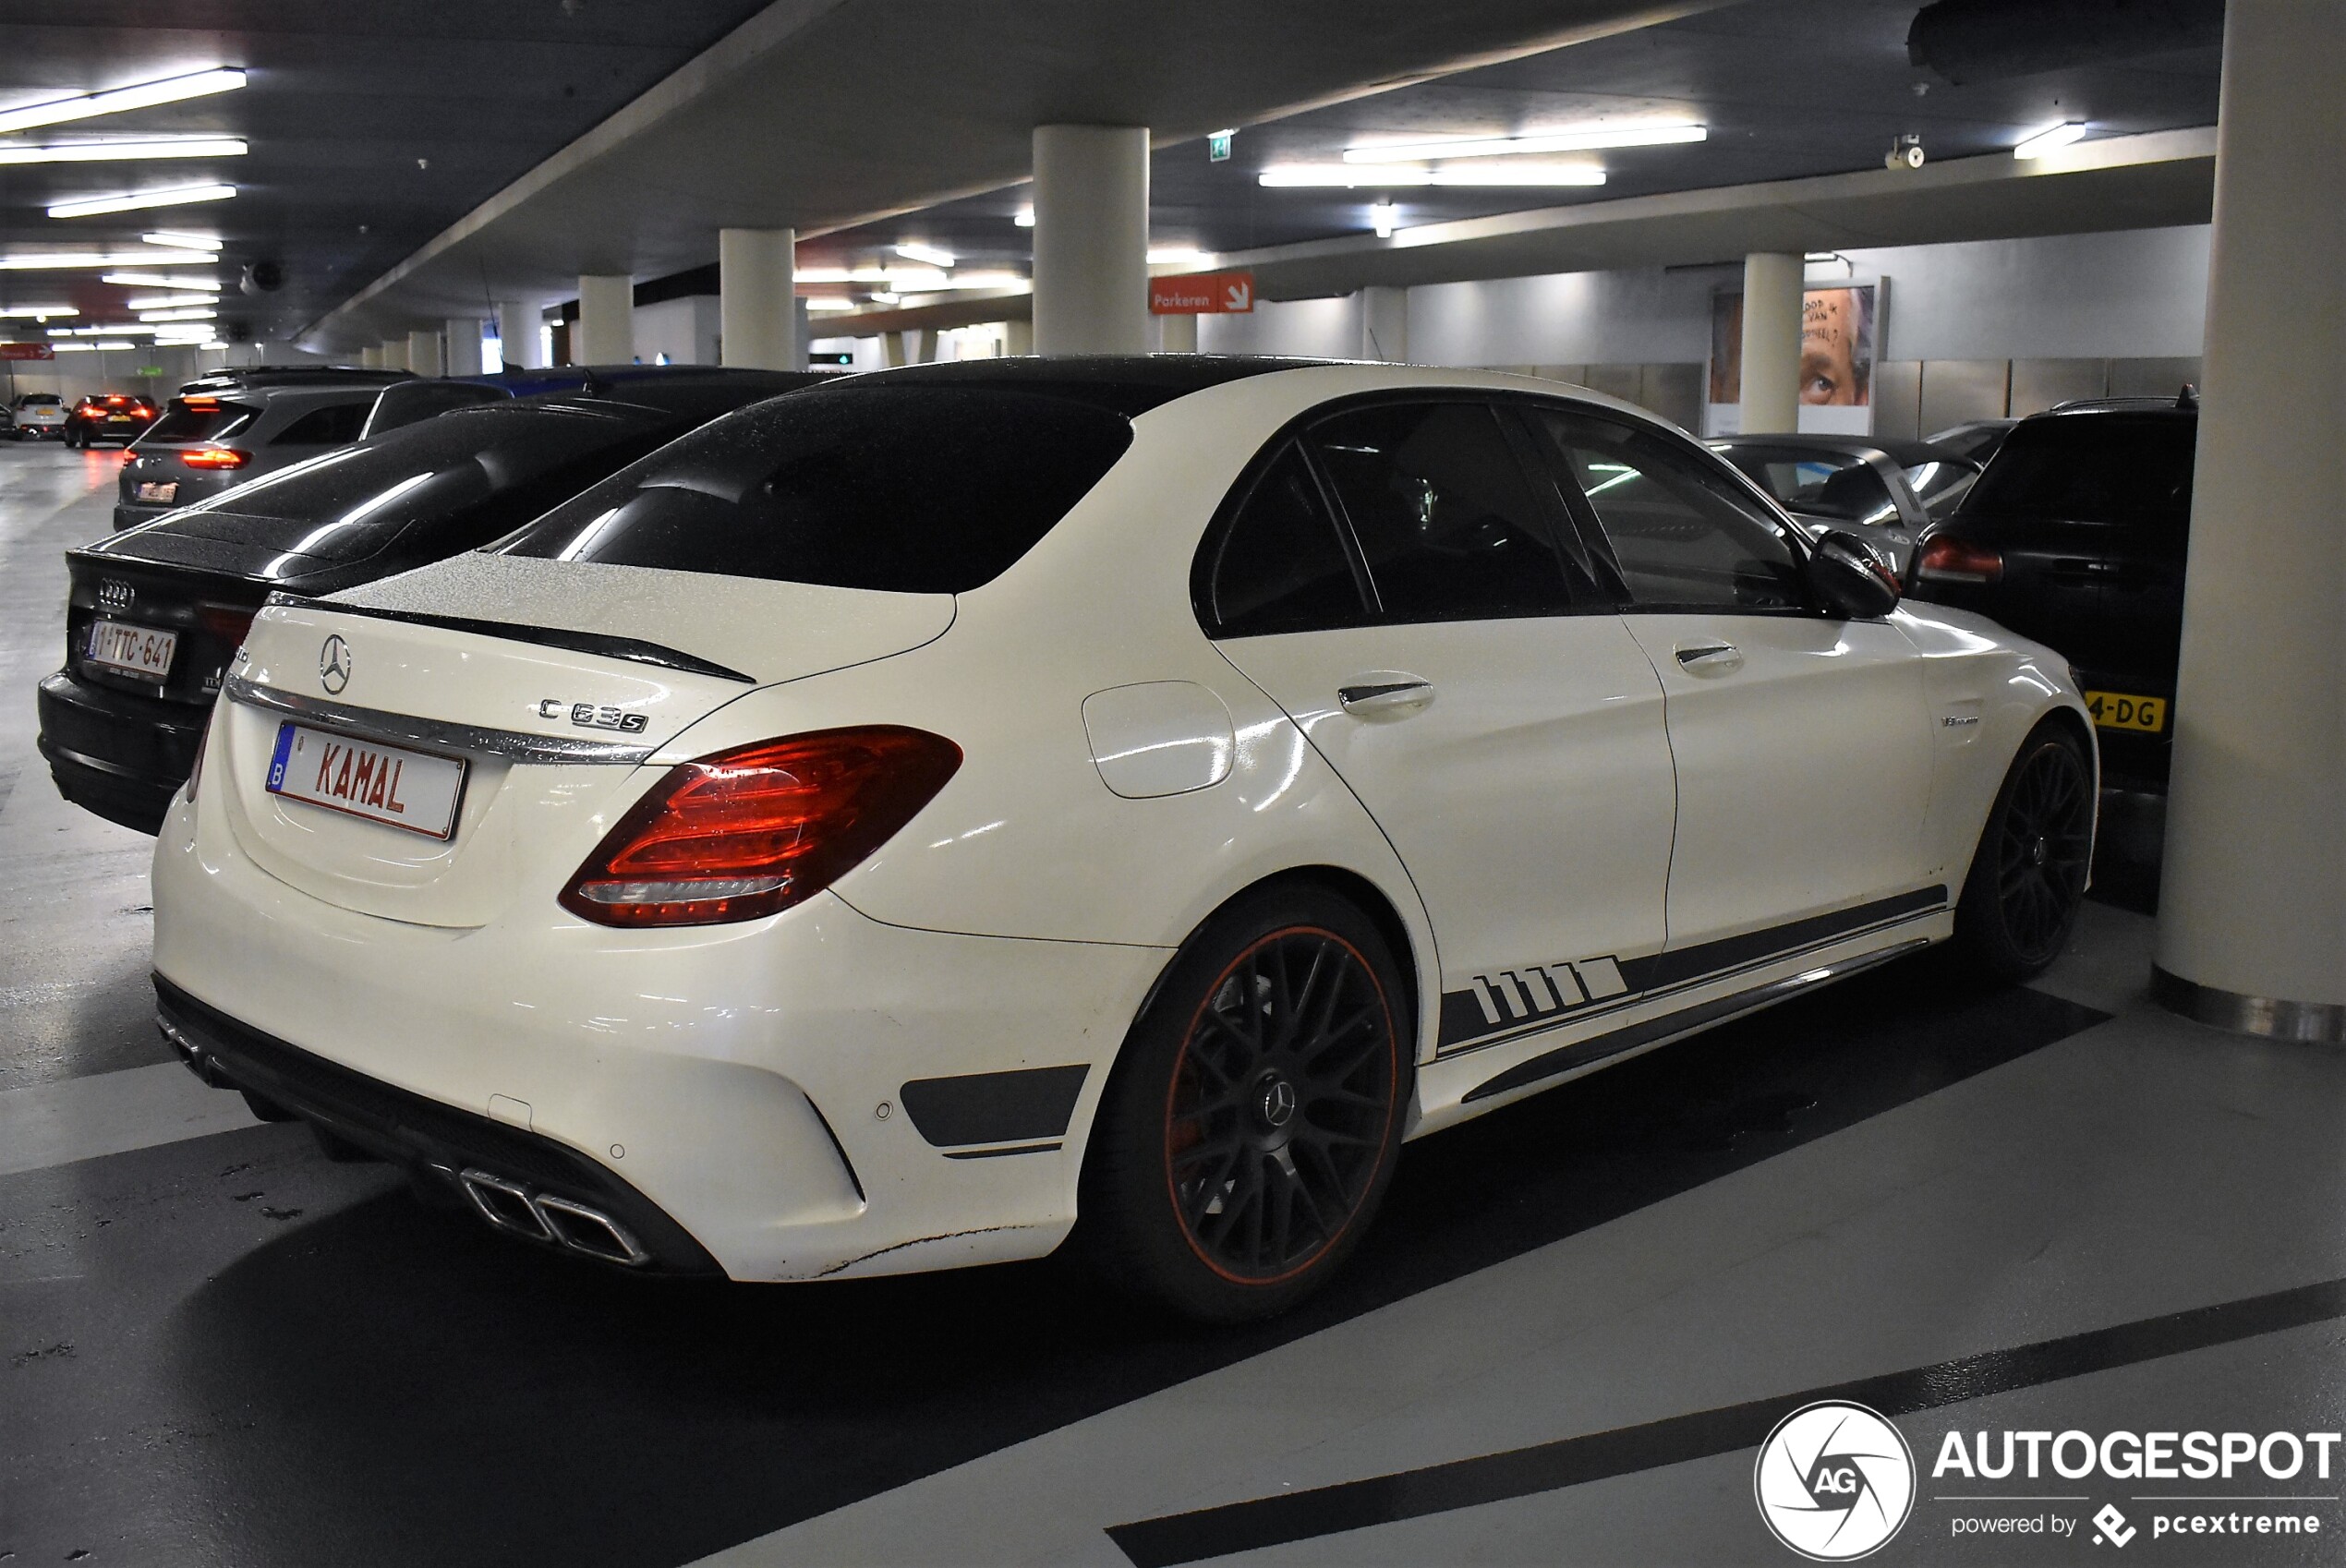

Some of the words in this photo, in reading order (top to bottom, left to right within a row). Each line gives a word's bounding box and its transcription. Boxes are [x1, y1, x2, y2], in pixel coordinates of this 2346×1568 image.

[1155, 292, 1210, 307] Parkeren
[538, 698, 562, 719] C
[272, 763, 283, 785] B
[315, 742, 405, 814] KAMAL
